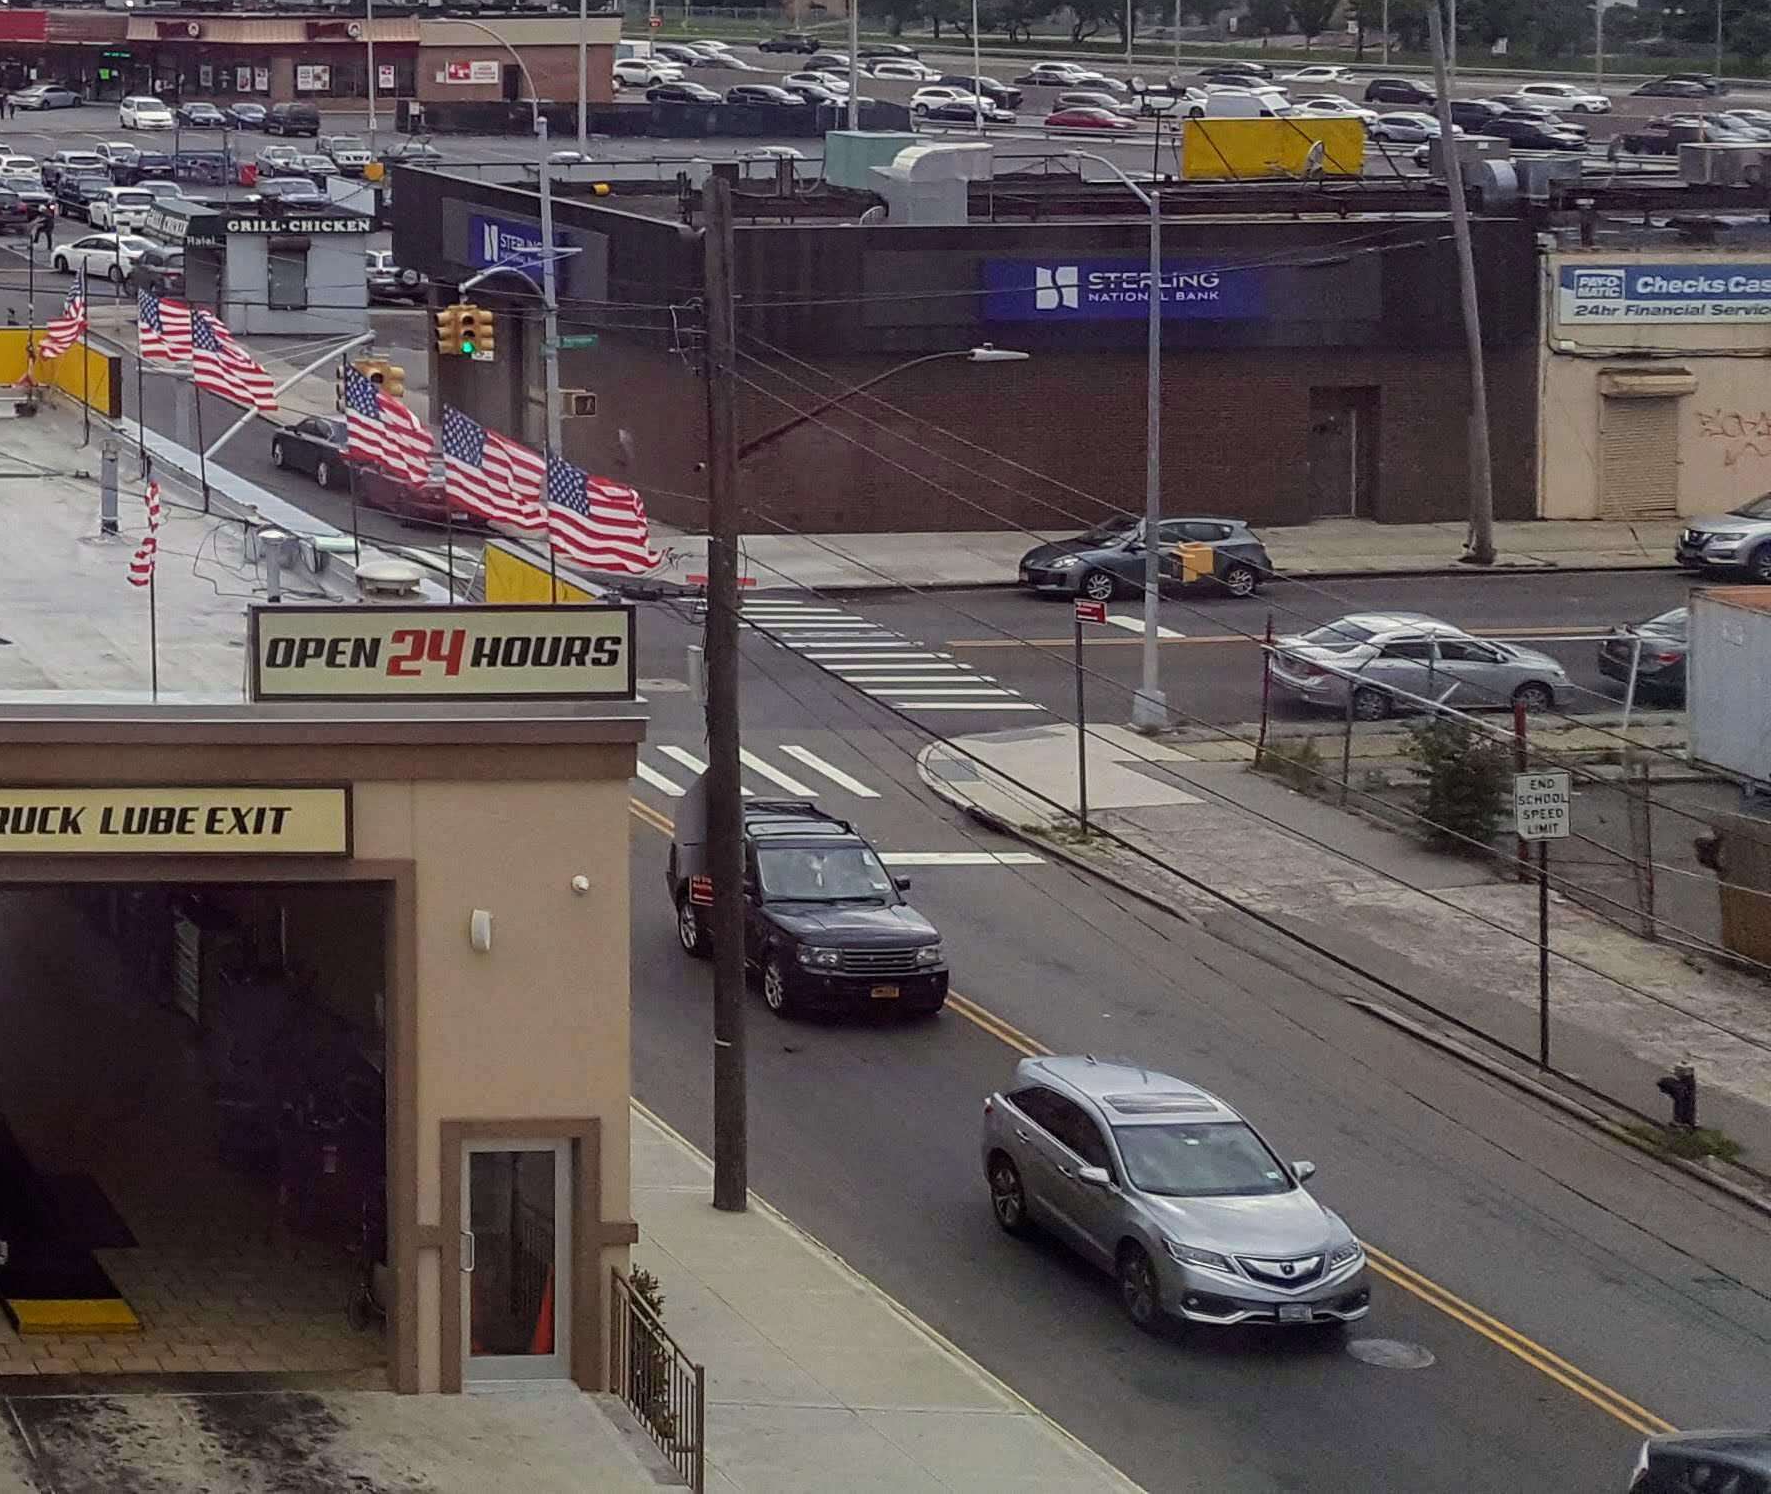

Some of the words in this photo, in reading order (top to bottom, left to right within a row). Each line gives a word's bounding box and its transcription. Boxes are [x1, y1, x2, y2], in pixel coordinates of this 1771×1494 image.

[226, 220, 282, 232] GRILL
[288, 218, 371, 232] CHICKEN
[1636, 276, 1725, 293] Checks
[1088, 291, 1169, 302] NATIONL
[1175, 290, 1220, 301] BANK
[1577, 287, 1622, 298] MATIC
[1574, 305, 1620, 317] 24hr
[1624, 304, 1707, 317] Financial
[265, 636, 382, 669] OPEN
[385, 628, 467, 677] 24
[469, 635, 623, 668] HOURS
[1530, 778, 1555, 790] END
[1518, 793, 1567, 806] SCHOOL
[99, 806, 200, 835] LUBE
[204, 806, 293, 835] EXIT
[1523, 808, 1564, 820] SPEED
[1527, 823, 1559, 835] LIMIT
